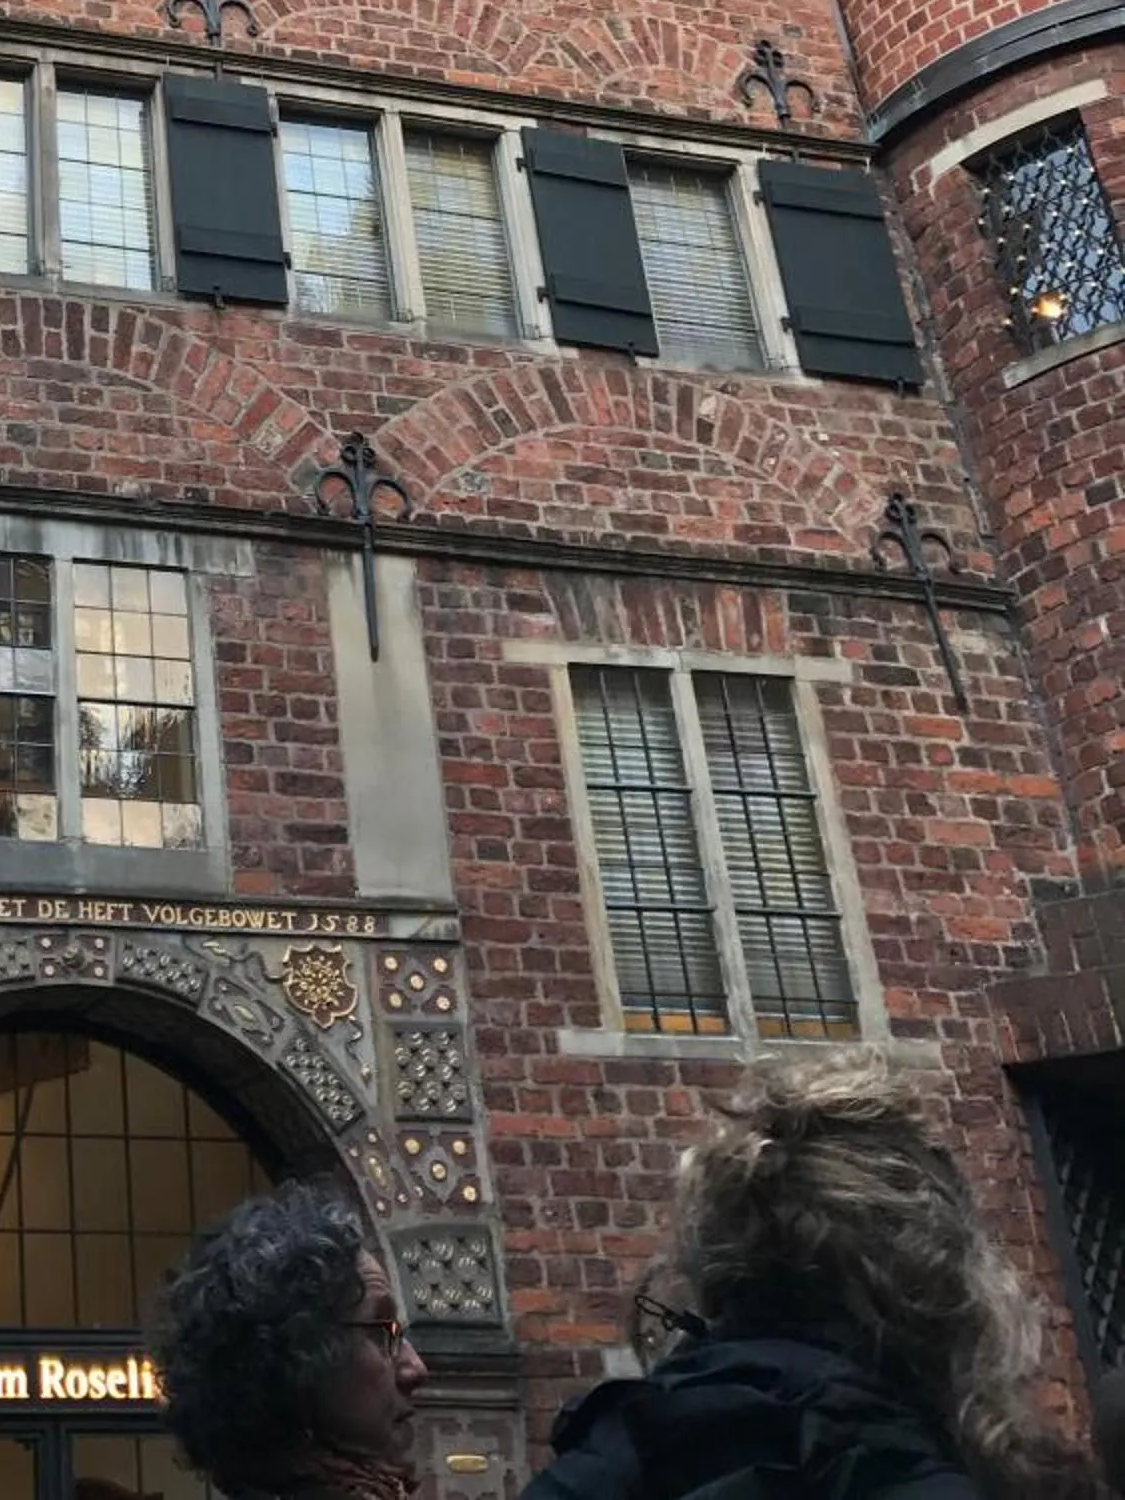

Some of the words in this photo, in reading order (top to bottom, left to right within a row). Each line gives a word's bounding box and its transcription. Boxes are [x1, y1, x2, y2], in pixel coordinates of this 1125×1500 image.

[37, 899, 69, 919] DE
[78, 900, 134, 922] HEFT
[38, 1353, 159, 1400] Roseli
